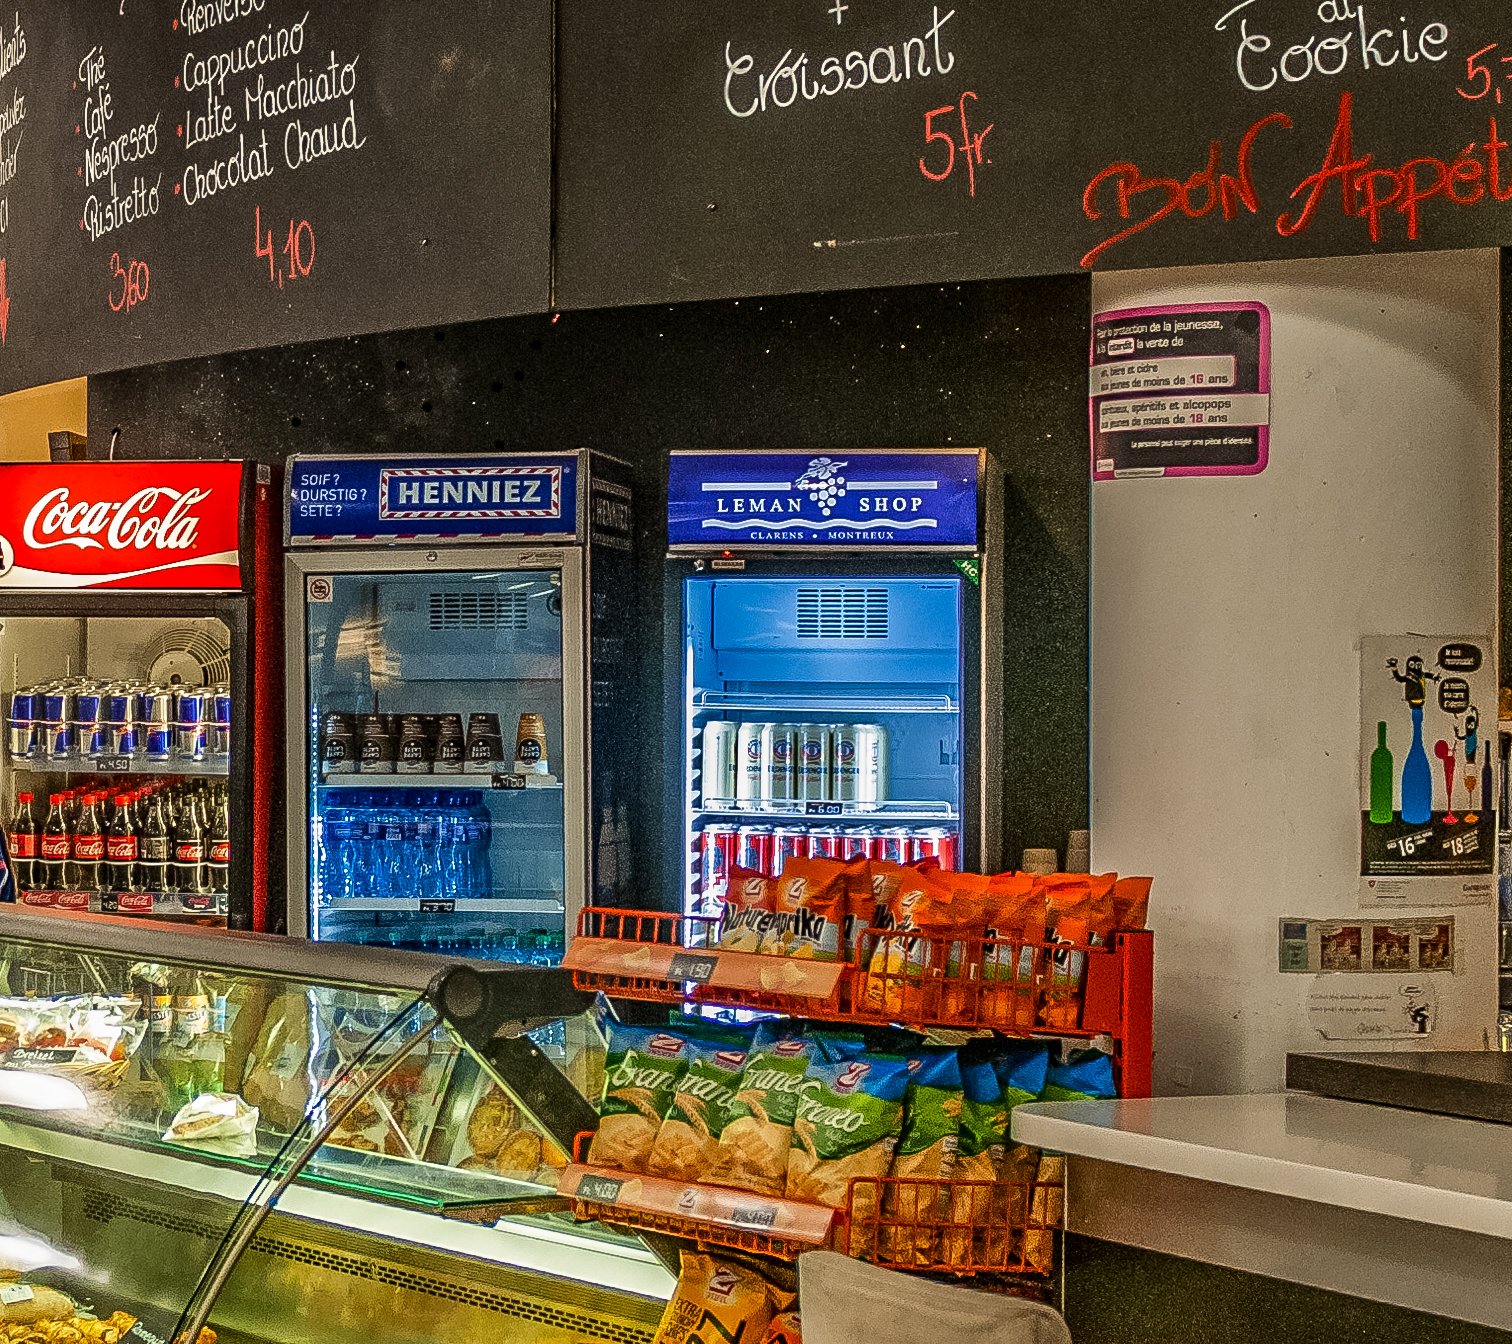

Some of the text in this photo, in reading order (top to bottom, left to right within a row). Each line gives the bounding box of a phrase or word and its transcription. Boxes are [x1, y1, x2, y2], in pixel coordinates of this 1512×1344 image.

[79, 45, 106, 91] Thé
[182, 10, 310, 114] Cappuccino
[85, 83, 113, 139] Café
[185, 49, 360, 150] Latte Macchiato
[86, 112, 161, 196] Nespresso
[182, 98, 367, 206] Chocolat Chaud
[84, 172, 162, 242] Ristretto
[23, 486, 212, 551] Coca-Cola
[399, 480, 542, 505] HENNIEZ
[717, 496, 923, 513] LEMAN SHOP
[750, 530, 894, 540] CLARENS MONTREUX
